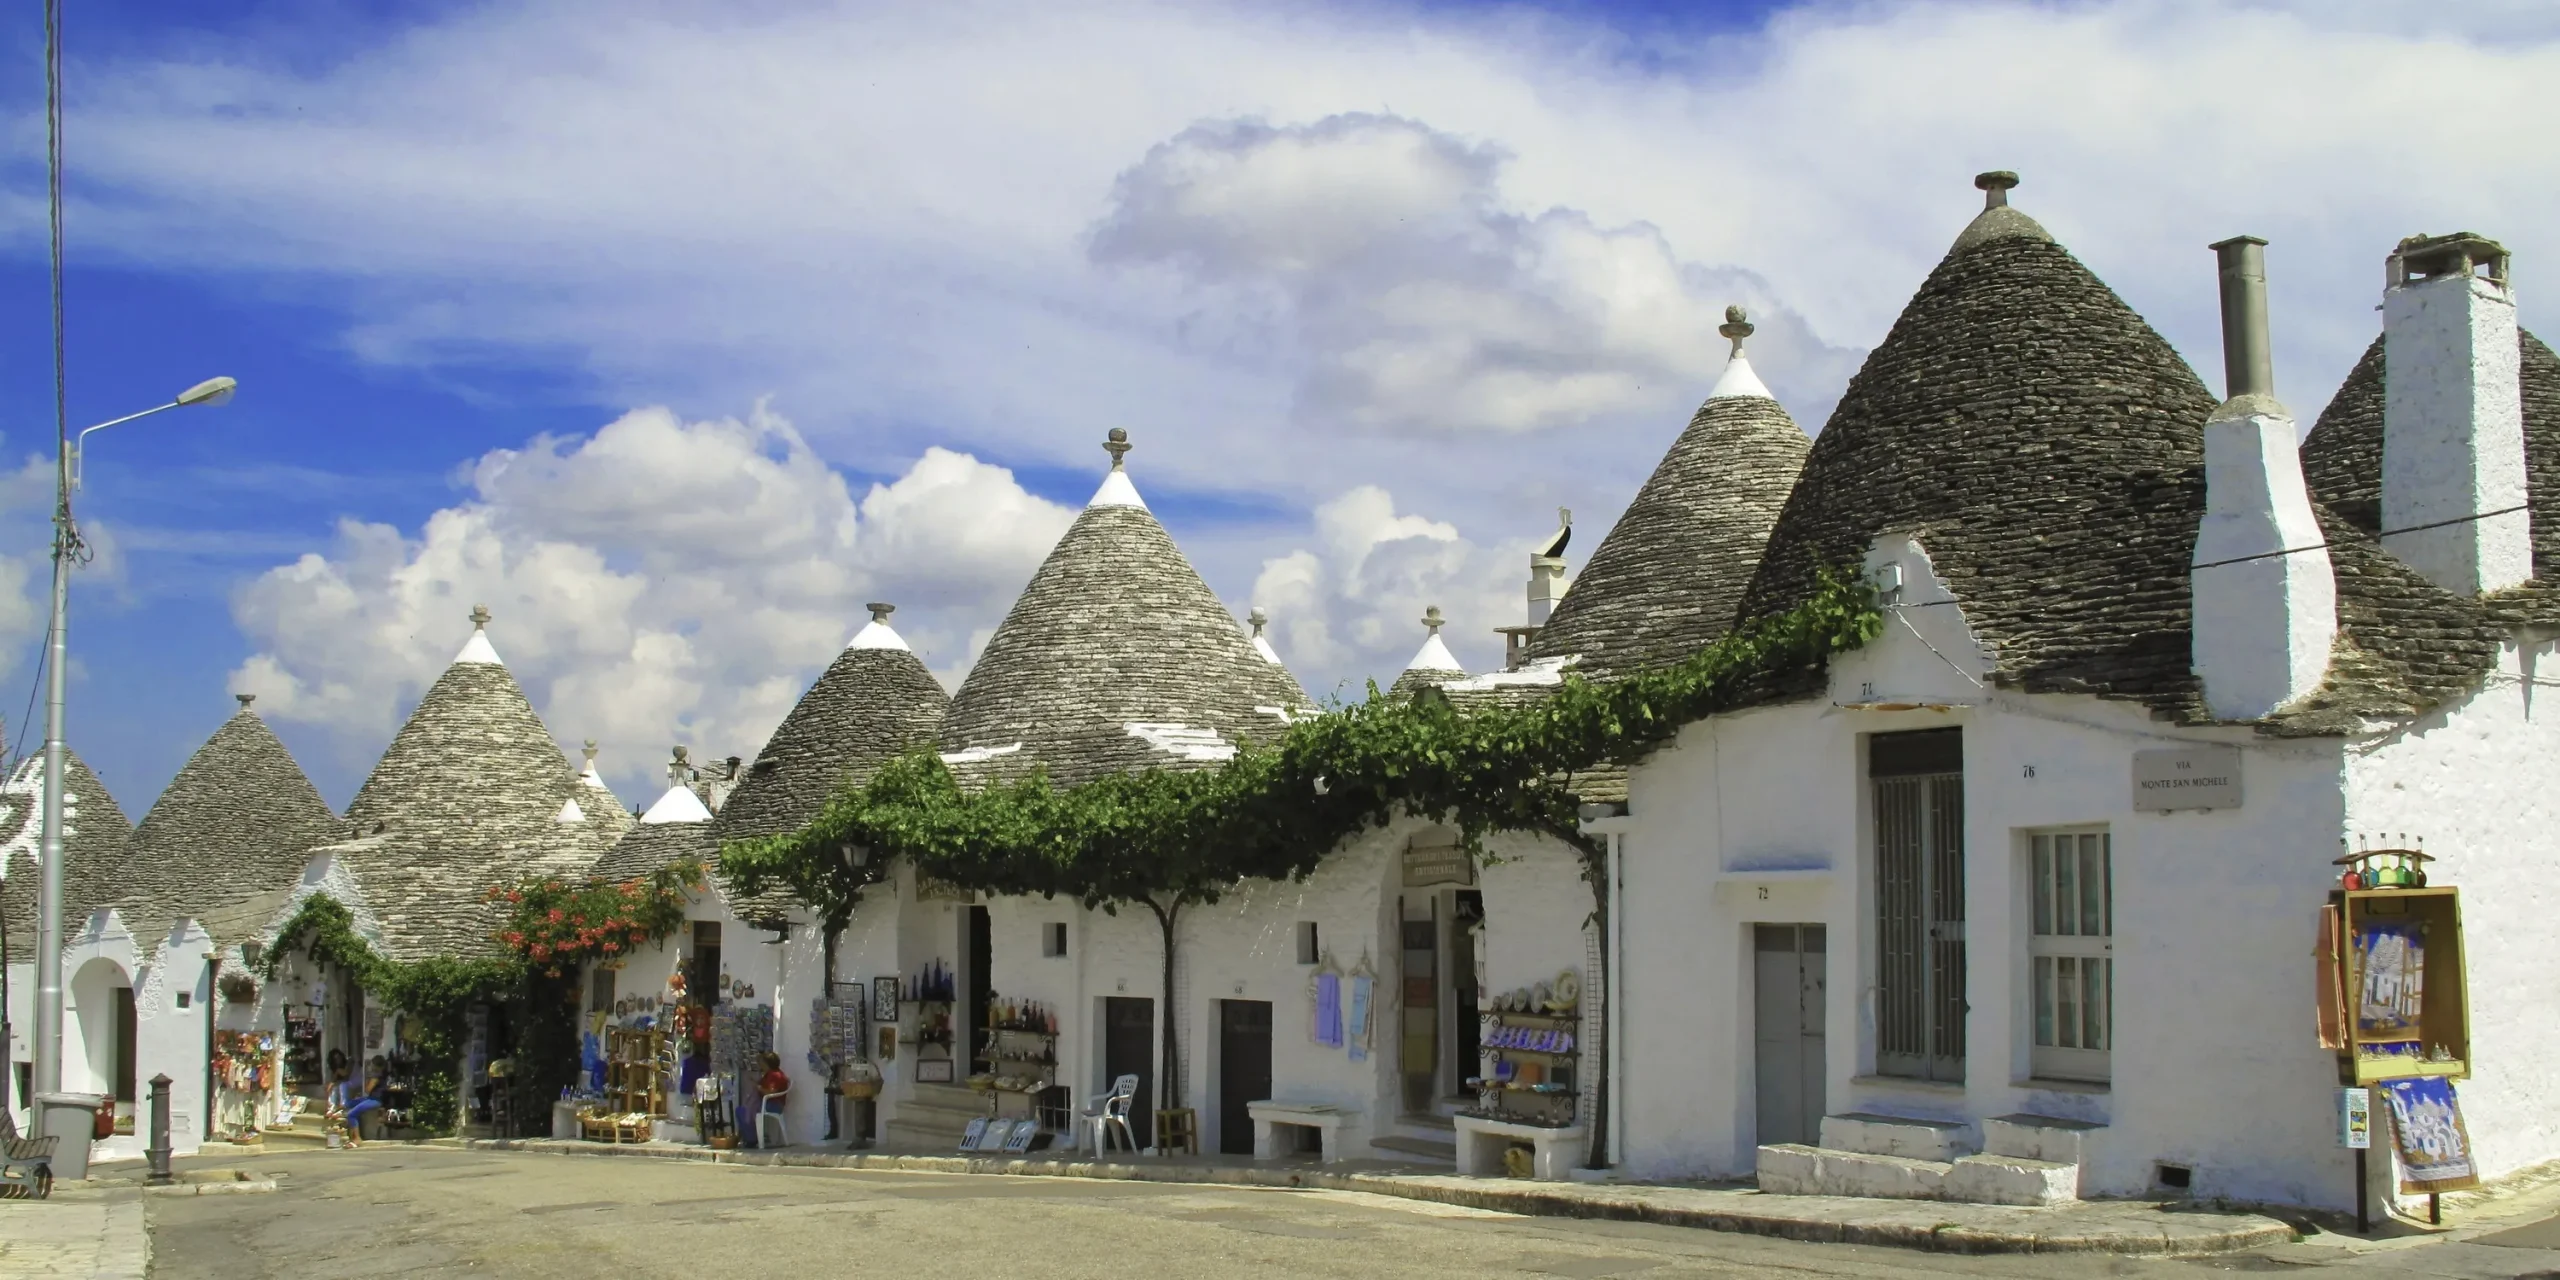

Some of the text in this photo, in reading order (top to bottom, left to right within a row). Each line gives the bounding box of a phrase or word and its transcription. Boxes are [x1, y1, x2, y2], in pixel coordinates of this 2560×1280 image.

[2022, 765, 2035, 779] 76
[2175, 761, 2192, 770] VIA
[2141, 776, 2229, 790] MONTE SAN MICHELE
[1758, 886, 1769, 900] 72
